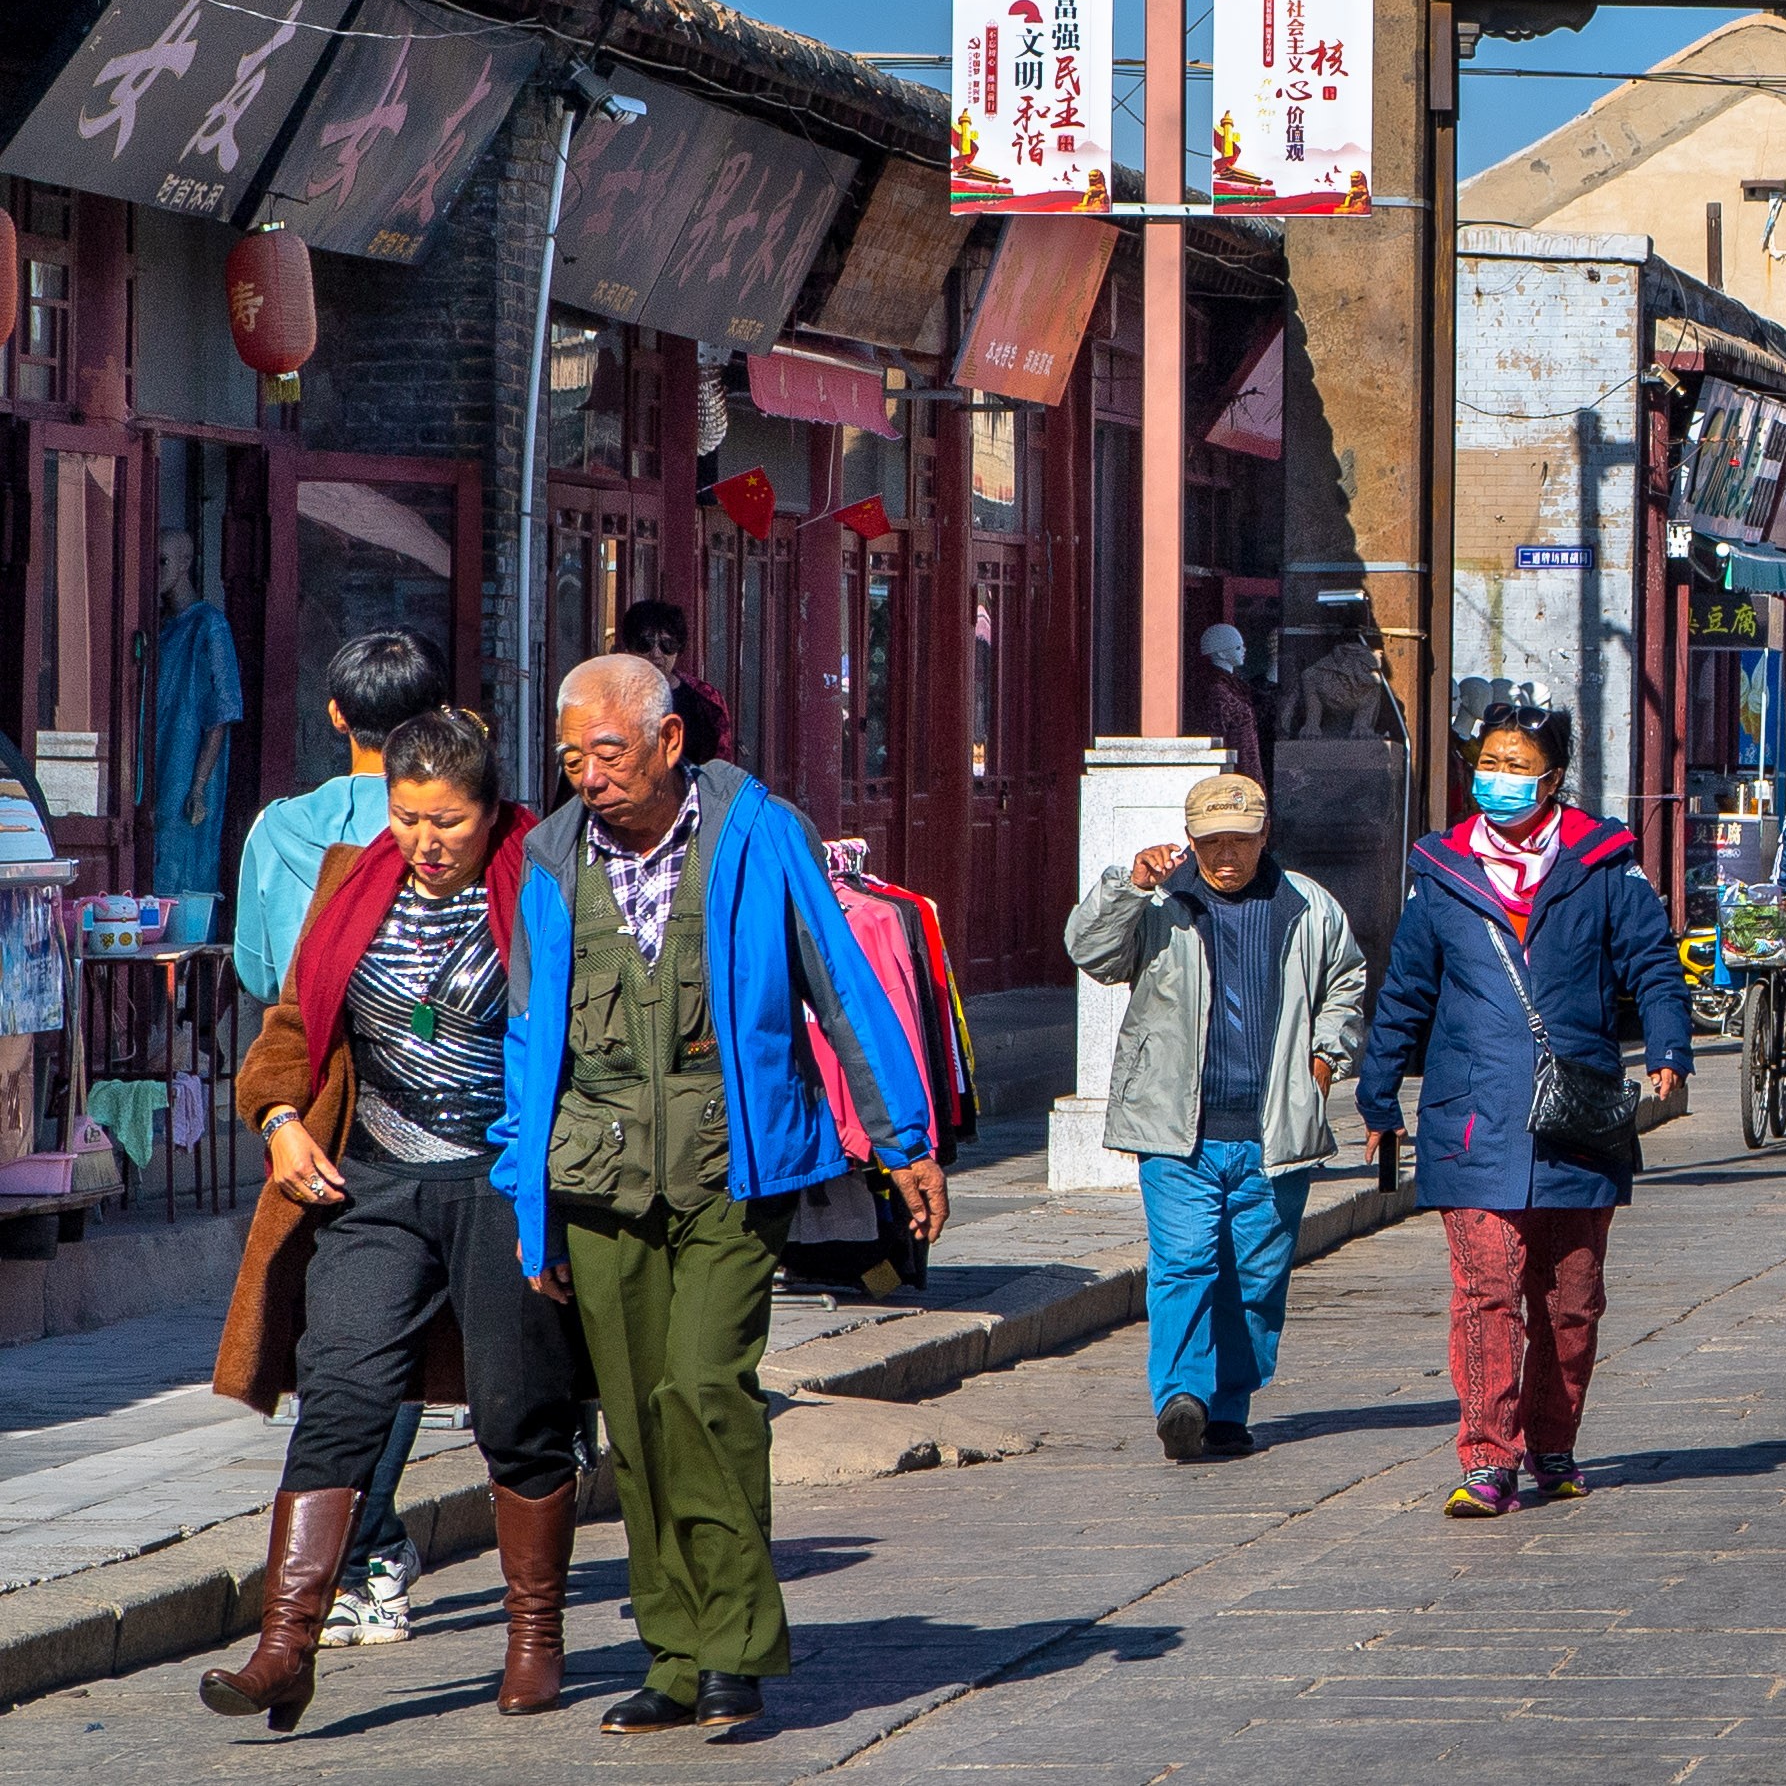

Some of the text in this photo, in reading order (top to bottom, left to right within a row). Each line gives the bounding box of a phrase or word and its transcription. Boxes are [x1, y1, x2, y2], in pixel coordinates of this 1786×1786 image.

[1011, 28, 1051, 166] 文明和谐
[1694, 822, 1742, 846] 臭豆腐
